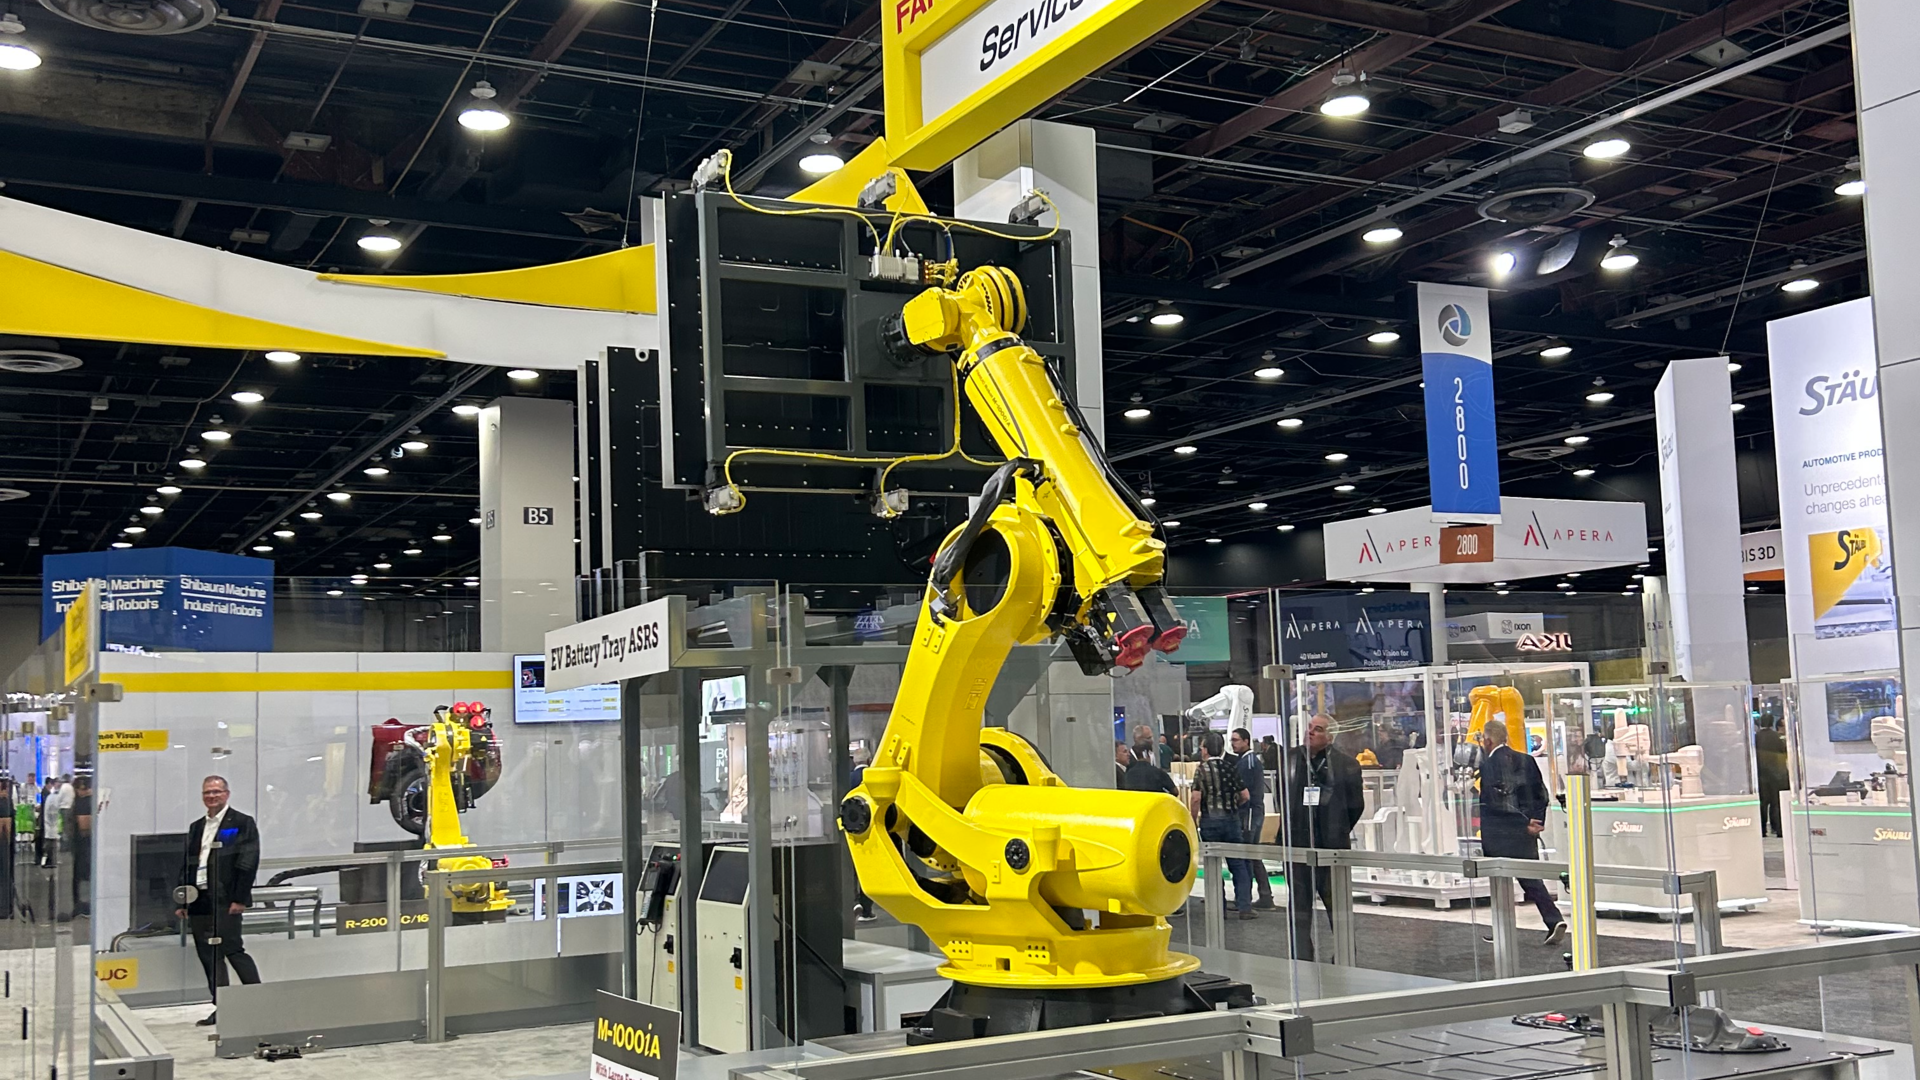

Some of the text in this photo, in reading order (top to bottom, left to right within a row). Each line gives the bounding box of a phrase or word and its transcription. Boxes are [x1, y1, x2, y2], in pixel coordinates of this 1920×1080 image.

[896, 0, 934, 35] FA
[1453, 377, 1469, 490] 2800
[1802, 453, 1857, 469] AUTOMOTIVE
[1805, 499, 1856, 515] changes
[528, 508, 549, 524] B5
[1553, 529, 1614, 542] APERA
[1386, 535, 1441, 553] APER
[1456, 534, 1478, 555] 2800
[1757, 545, 1776, 561] 3D
[52, 577, 165, 592] Shibaa Machine
[180, 577, 266, 599] Shibaura Machine
[116, 598, 160, 611] Robots
[184, 598, 263, 618] Industrial Robots
[1303, 620, 1340, 632] APERA
[1377, 620, 1424, 629] APERA
[551, 621, 659, 672] EV Battery Tray ASRS
[1383, 649, 1399, 657] Vision
[1400, 649, 1409, 657] for
[1364, 659, 1386, 667] Robotic
[115, 731, 144, 739] Visual
[597, 1017, 661, 1060] M-1000iA
